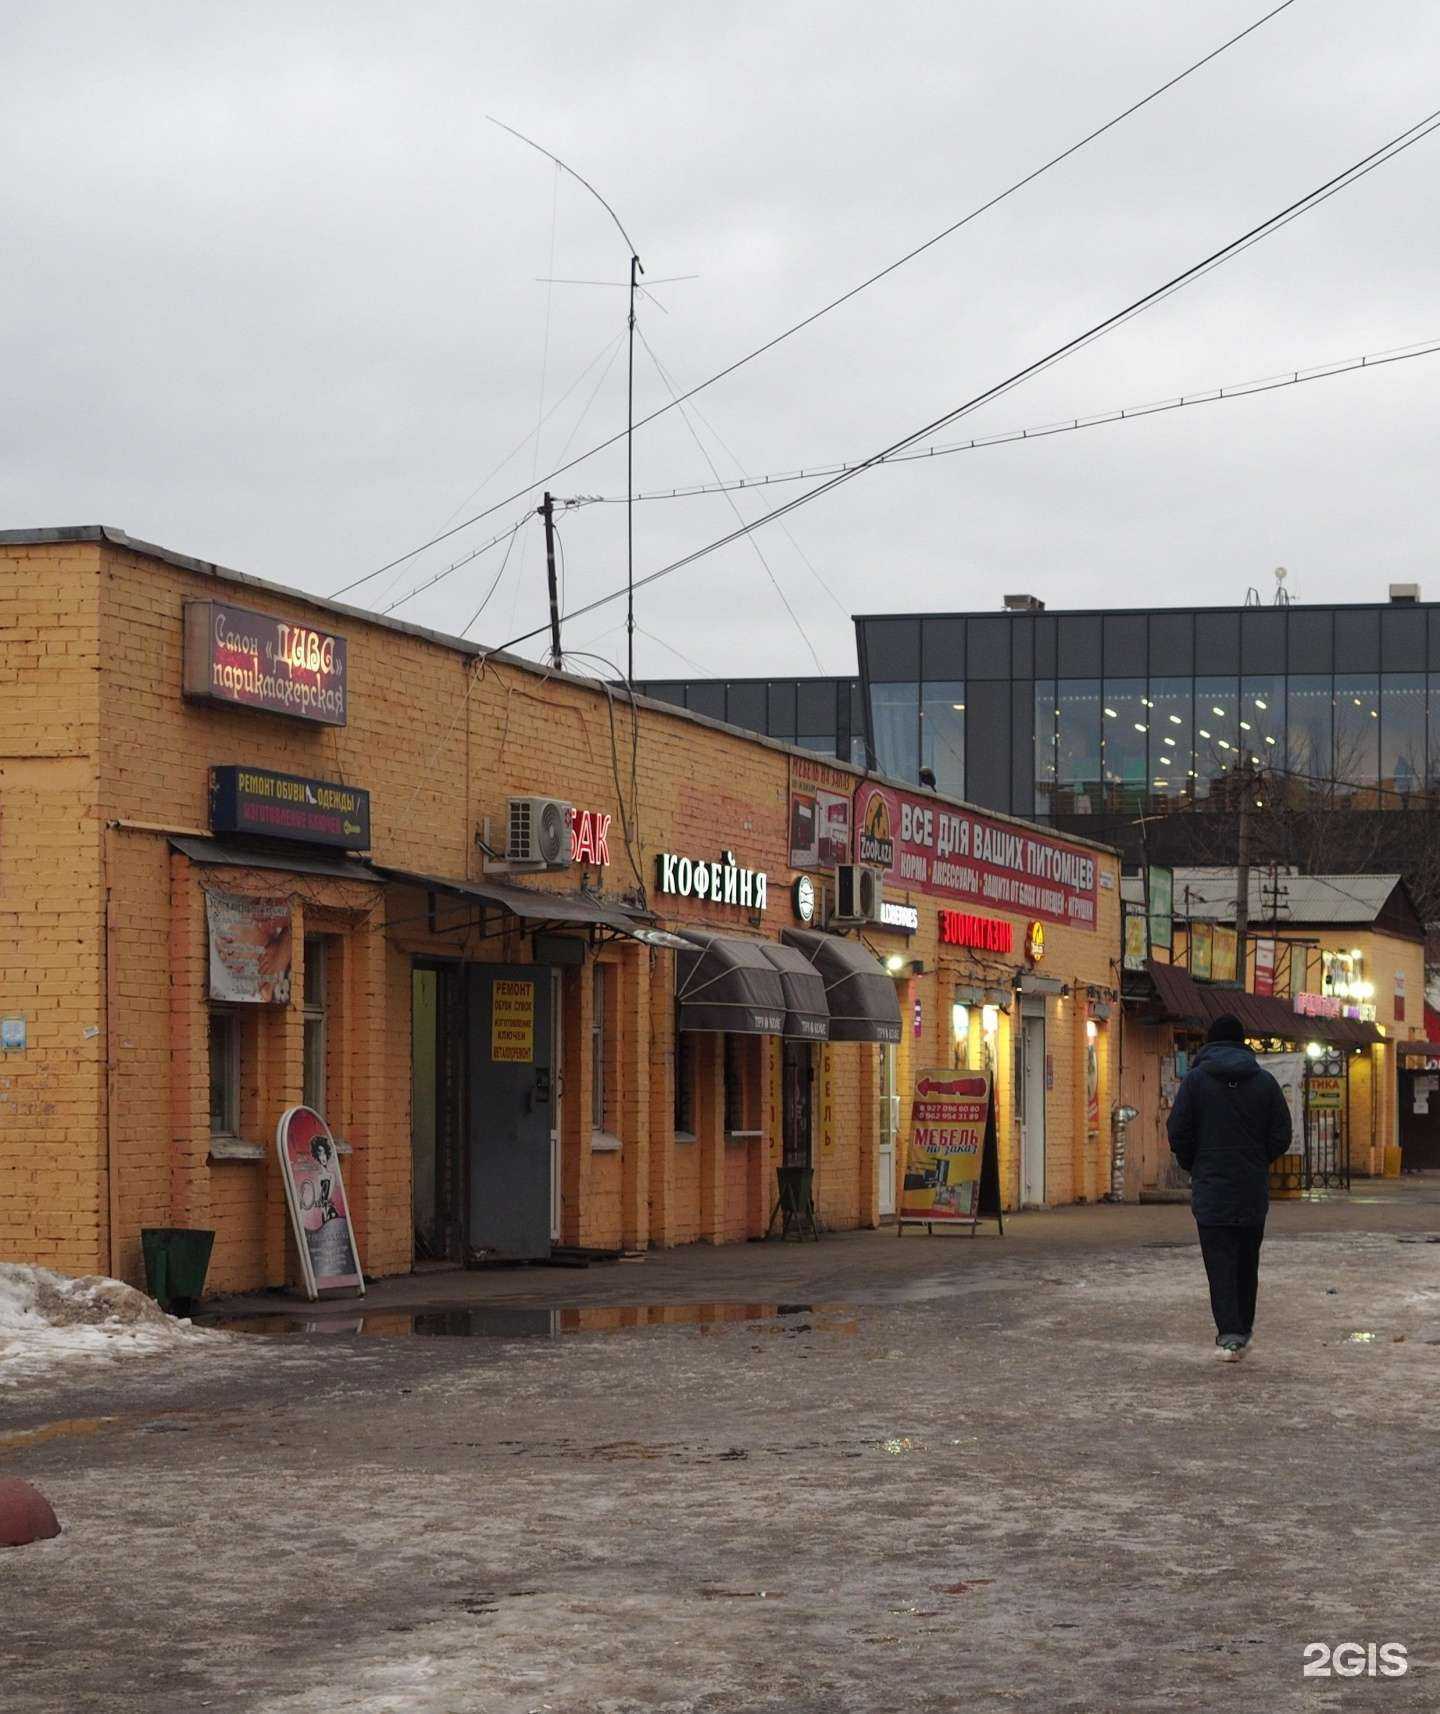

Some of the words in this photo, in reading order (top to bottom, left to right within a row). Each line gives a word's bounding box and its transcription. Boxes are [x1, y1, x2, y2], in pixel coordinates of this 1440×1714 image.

[215, 613, 258, 656] Салон
[213, 657, 344, 717] парикмахерская
[239, 772, 274, 797] РЕМОНТ
[276, 780, 305, 802] ОБУВИ
[317, 787, 355, 813] ОДЕЖДЫ
[901, 803, 933, 847] ВСЕ
[937, 813, 969, 857] ДЛЯ
[973, 824, 1024, 872] ВАШИХ
[1027, 840, 1094, 893] ПИТОМЦЕВ
[663, 850, 768, 910] КОФЕЙНЯ
[900, 852, 927, 882] КОРМА
[932, 861, 979, 894] АКСЕССУАРЫ
[983, 873, 1010, 902] ЗАЩИТА
[943, 908, 1014, 954] ЗООМАГАЗИН
[496, 982, 532, 996] РЕМОНТ
[914, 1128, 979, 1146] МЕБЕЛЬ
